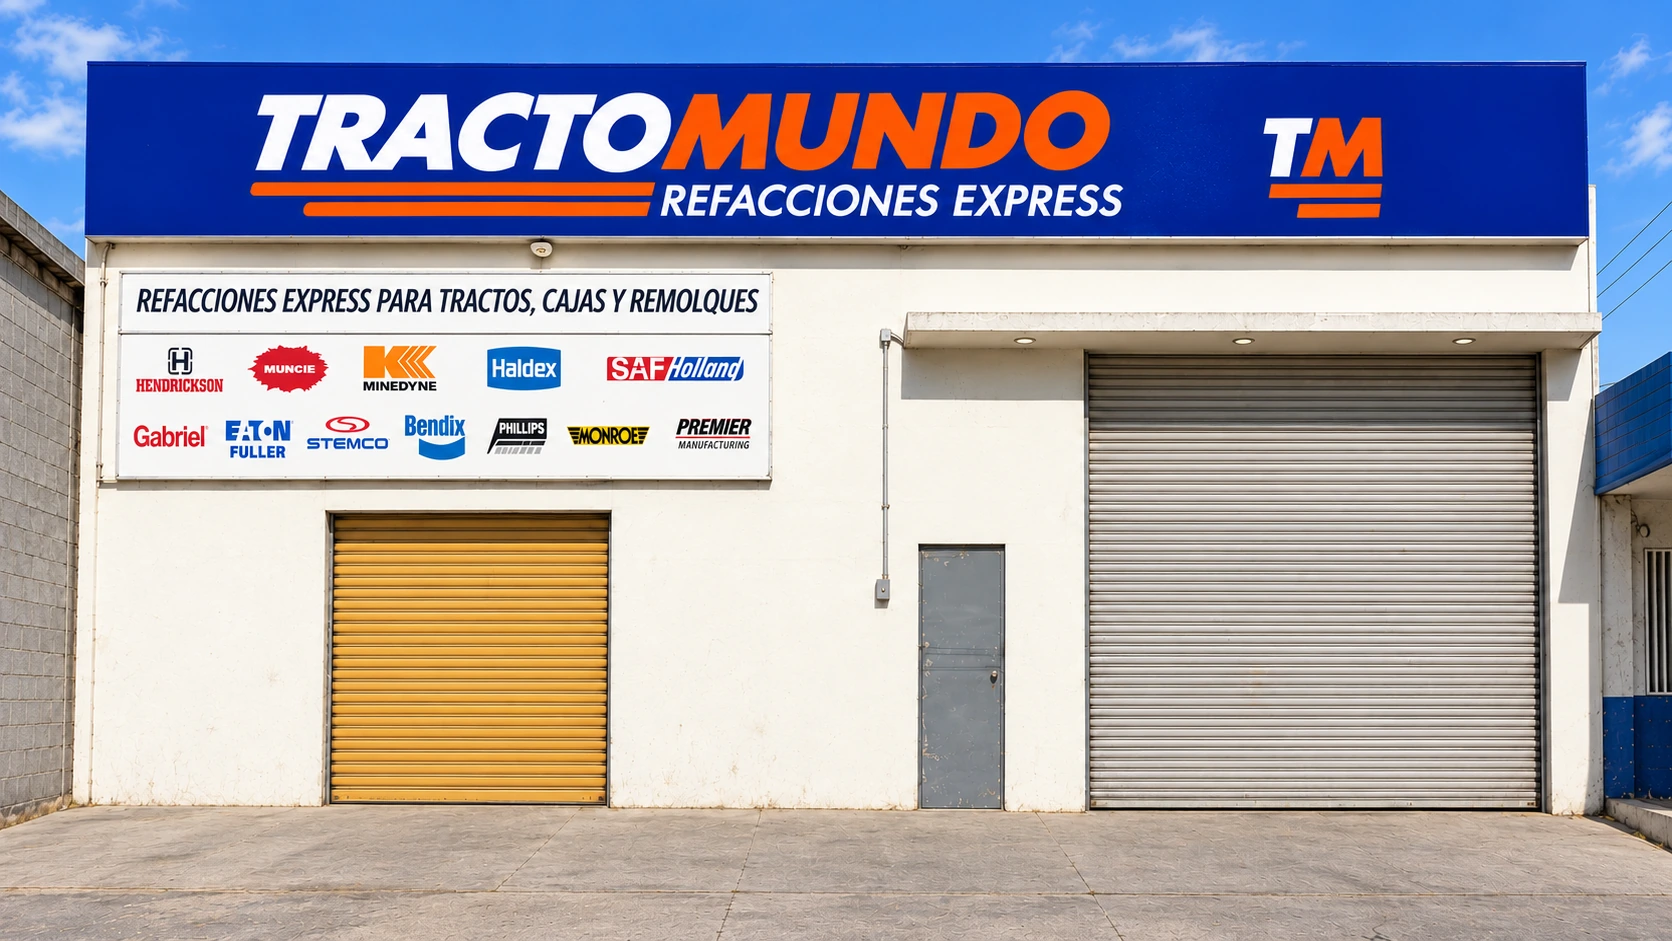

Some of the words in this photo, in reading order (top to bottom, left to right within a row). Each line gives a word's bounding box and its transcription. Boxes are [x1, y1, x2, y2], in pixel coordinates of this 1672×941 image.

[255, 89, 1112, 173] TRACTOMUNDO
[1264, 117, 1383, 177] TM
[661, 184, 940, 218] REFACCIONES
[951, 184, 1124, 218] EXPRESS
[136, 288, 278, 313] REFACCIONES
[282, 288, 372, 313] EXPRESS
[376, 288, 432, 313] PARA
[439, 288, 536, 317] TRACTOS,
[542, 288, 607, 313] CAJAS
[613, 288, 627, 313] Y
[629, 288, 760, 316] REMOLQUES
[264, 364, 315, 374] MUNCIE
[492, 358, 557, 378] Haldex
[611, 357, 665, 380] SAF
[669, 357, 743, 381] Holland
[135, 378, 224, 392] HENDRICKSON
[363, 381, 437, 391] MINEDYNE
[404, 415, 466, 436] Bendix
[499, 422, 545, 434] PHILLIPS
[676, 418, 752, 435] PREMIER
[133, 425, 205, 447] Gabriel
[307, 437, 389, 450] STEMCO
[579, 427, 638, 445] MONROE
[678, 441, 750, 449] MANUFACTURING
[230, 446, 286, 458] FULLER
